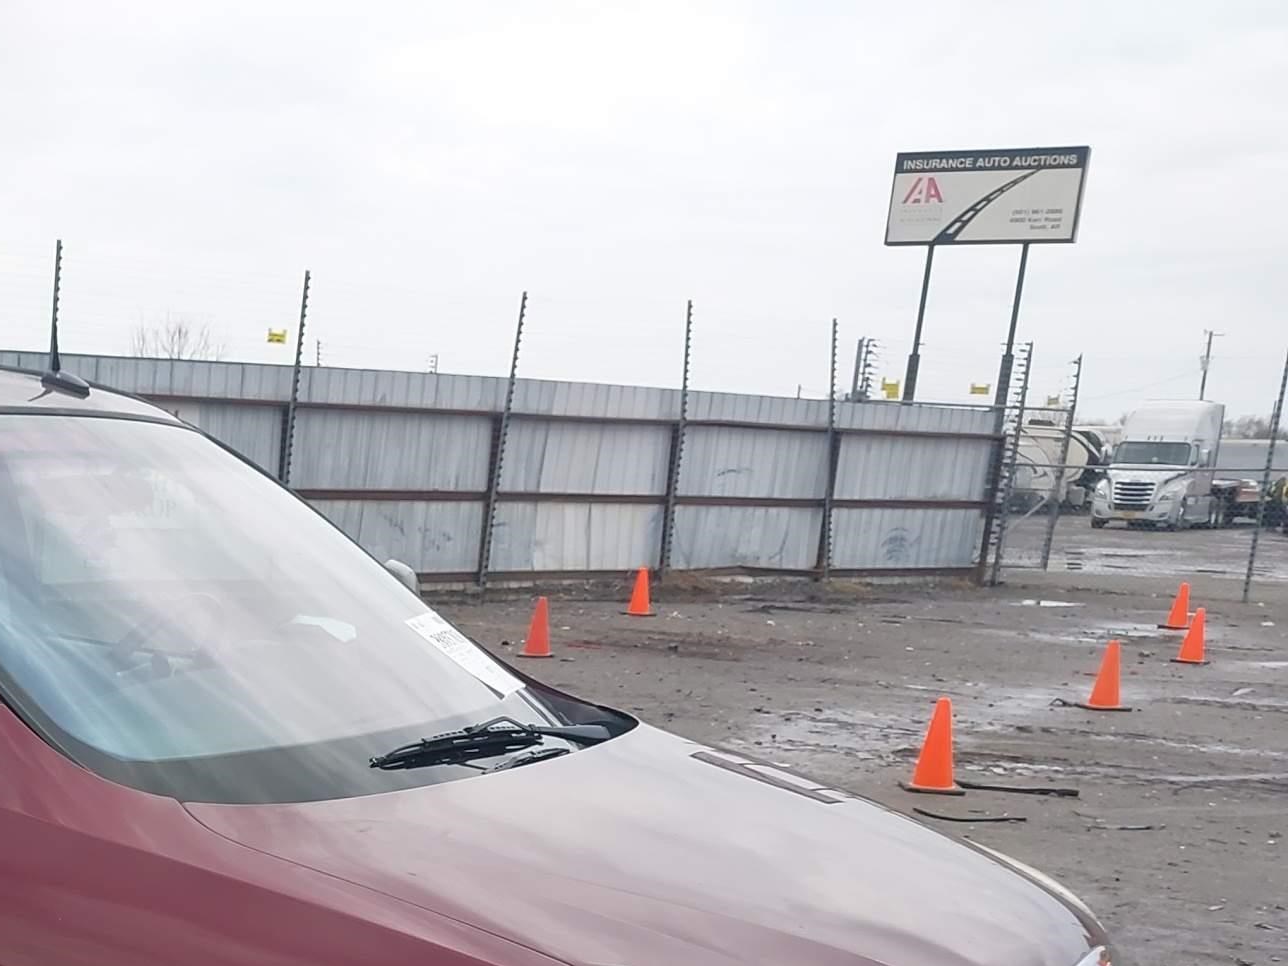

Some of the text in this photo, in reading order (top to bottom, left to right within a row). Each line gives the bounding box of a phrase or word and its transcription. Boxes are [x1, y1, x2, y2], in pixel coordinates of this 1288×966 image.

[903, 154, 1078, 170] INSURANCE AUTO AUCTIONS
